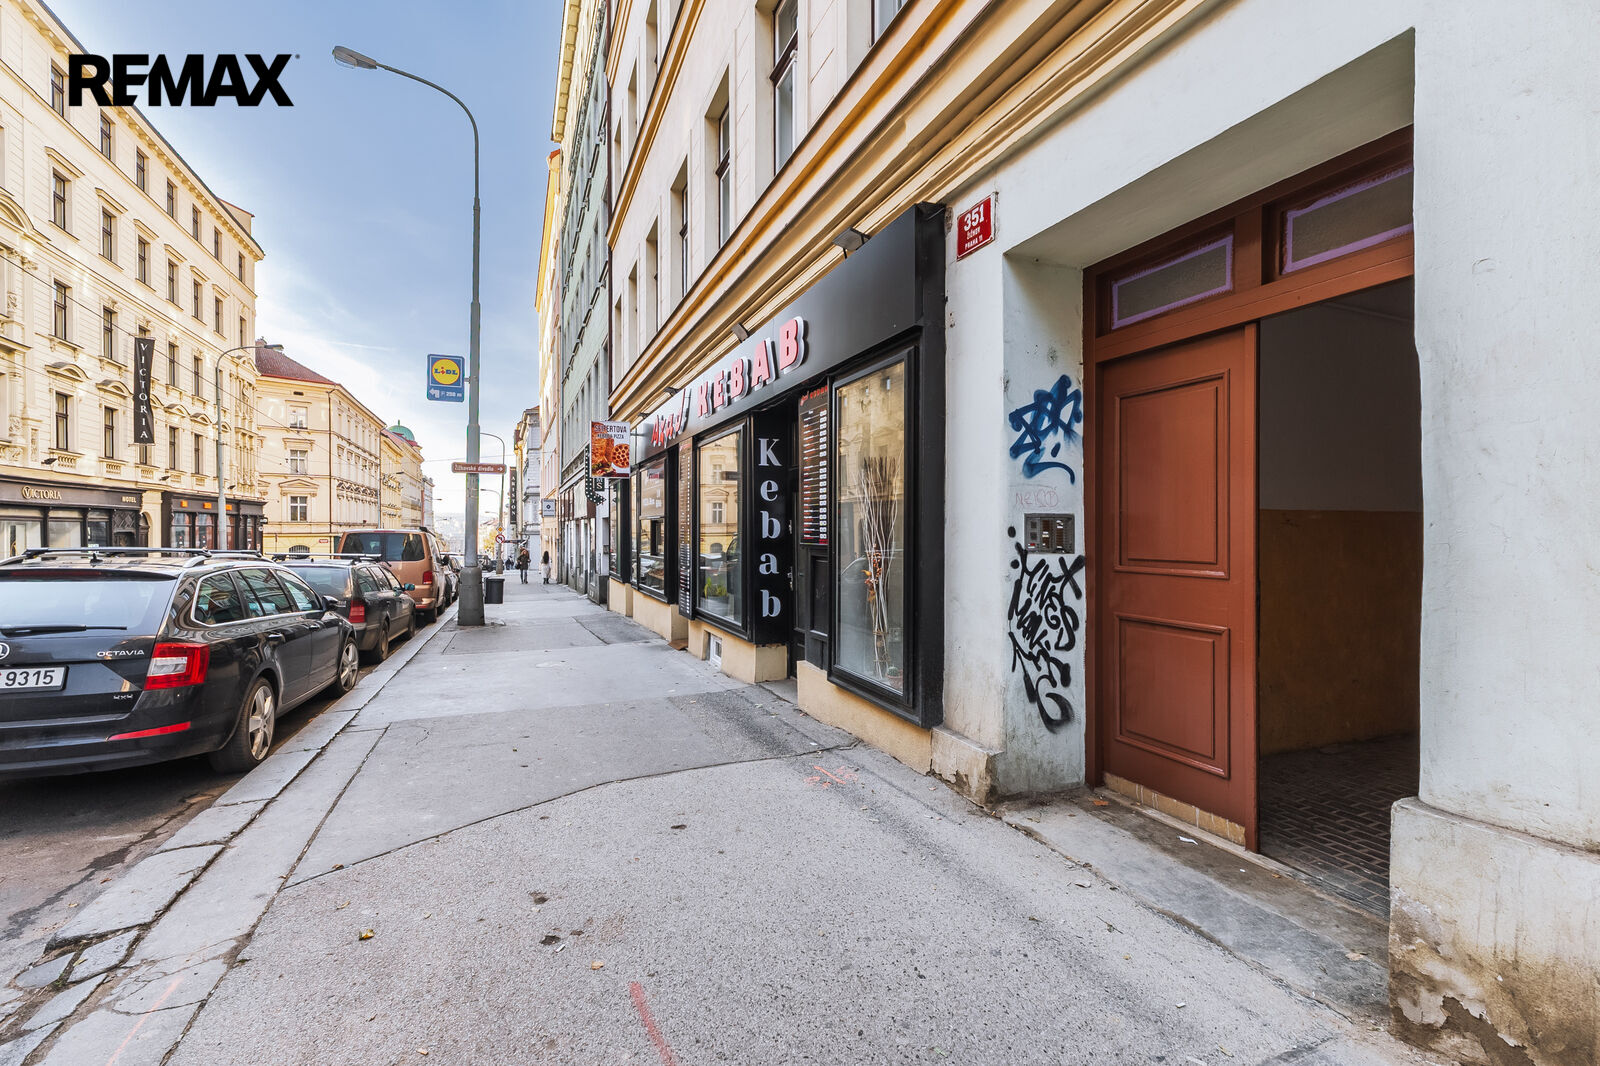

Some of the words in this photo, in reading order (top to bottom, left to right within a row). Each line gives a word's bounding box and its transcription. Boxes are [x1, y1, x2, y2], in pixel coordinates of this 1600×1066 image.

[964, 204, 984, 231] 351
[698, 316, 803, 419] KEBAB
[139, 343, 149, 439] VICTORIA
[22, 485, 62, 500] VICTORIA
[758, 438, 782, 618] Kebab
[97, 649, 145, 657] OCTAVIA
[5, 669, 55, 687] 9315
